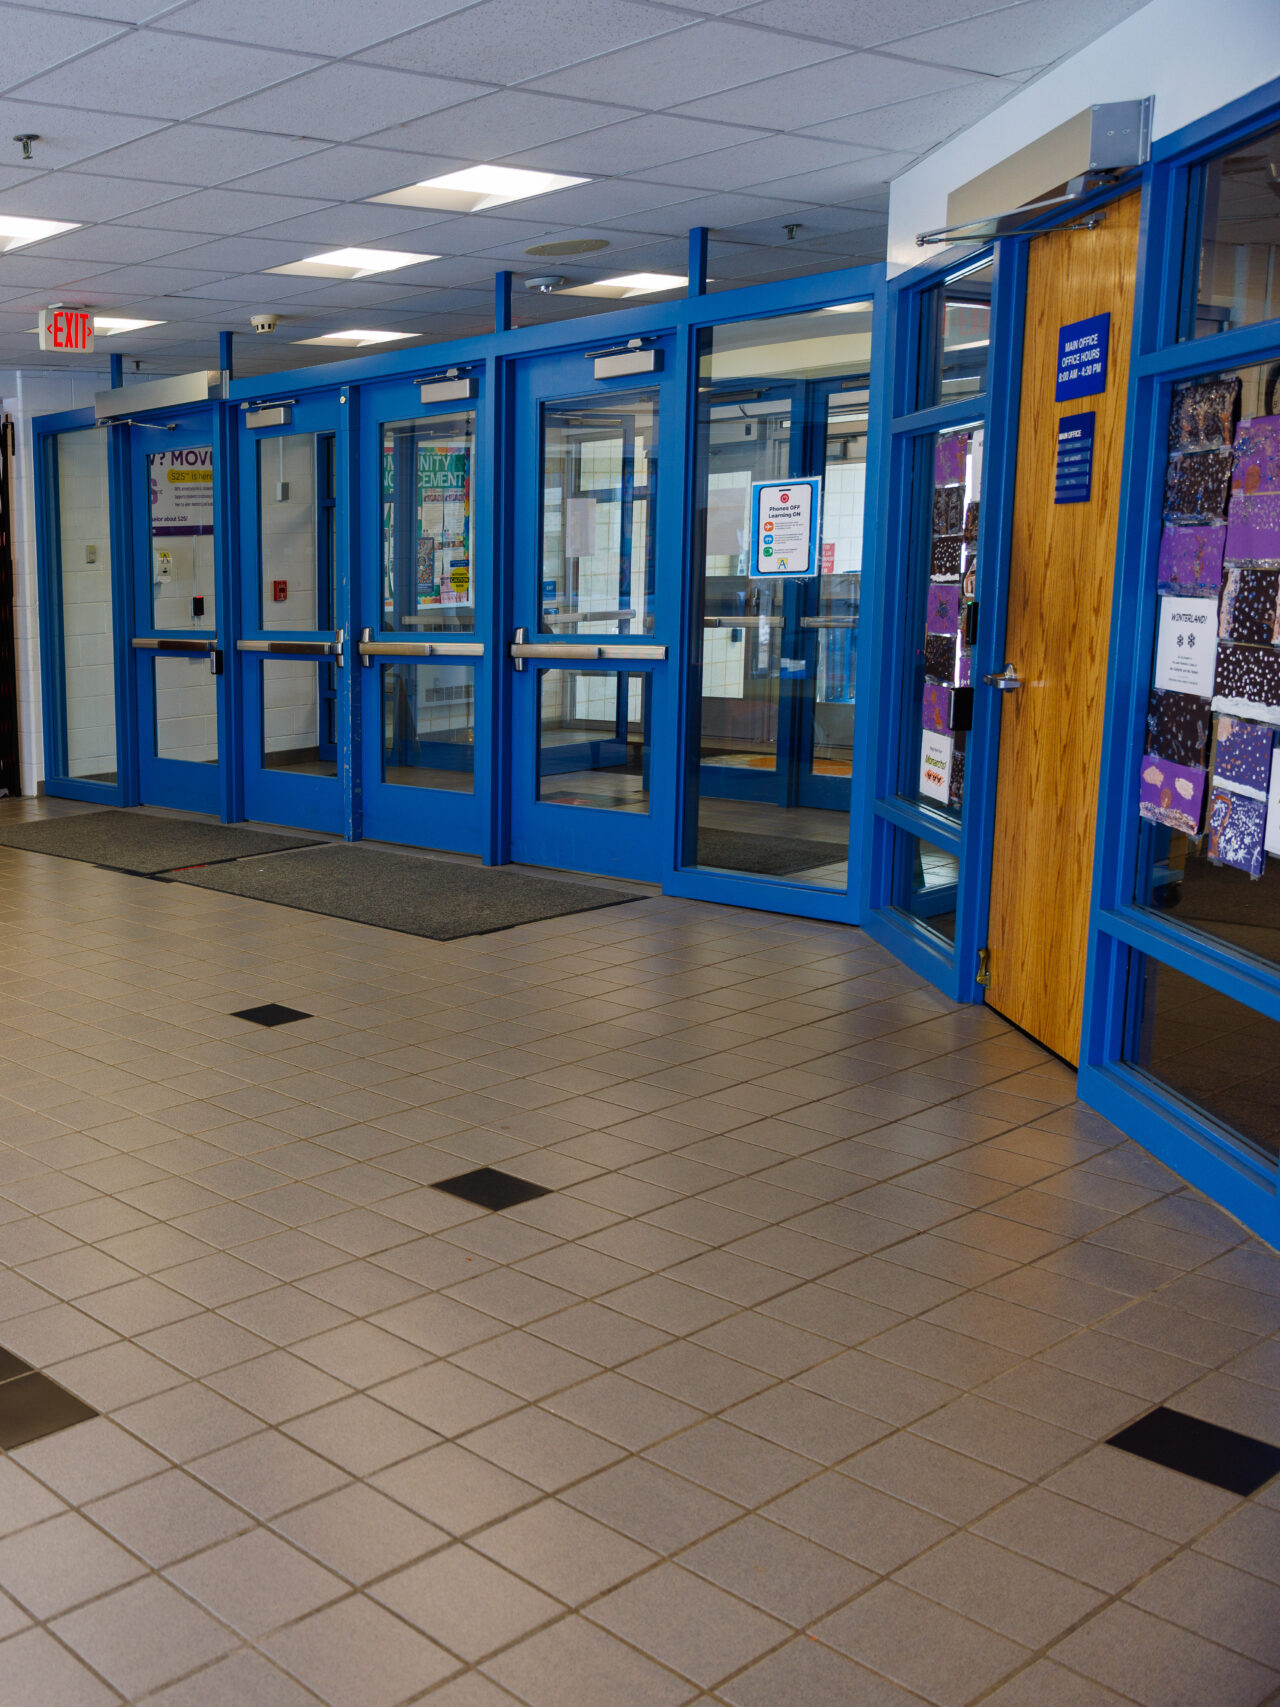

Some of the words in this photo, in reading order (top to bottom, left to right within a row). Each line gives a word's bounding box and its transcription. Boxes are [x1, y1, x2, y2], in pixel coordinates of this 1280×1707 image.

[53, 311, 89, 350] EXIT
[1065, 340, 1079, 352] MAIN
[1079, 333, 1099, 348] OFFICE
[1061, 353, 1080, 367] OFFICE
[1081, 348, 1100, 362] HOURS
[1058, 371, 1070, 382] 8:00
[1069, 368, 1079, 379] AM
[1082, 365, 1093, 376] 4:30
[1092, 362, 1102, 374] PM
[171, 450, 213, 466] MOV
